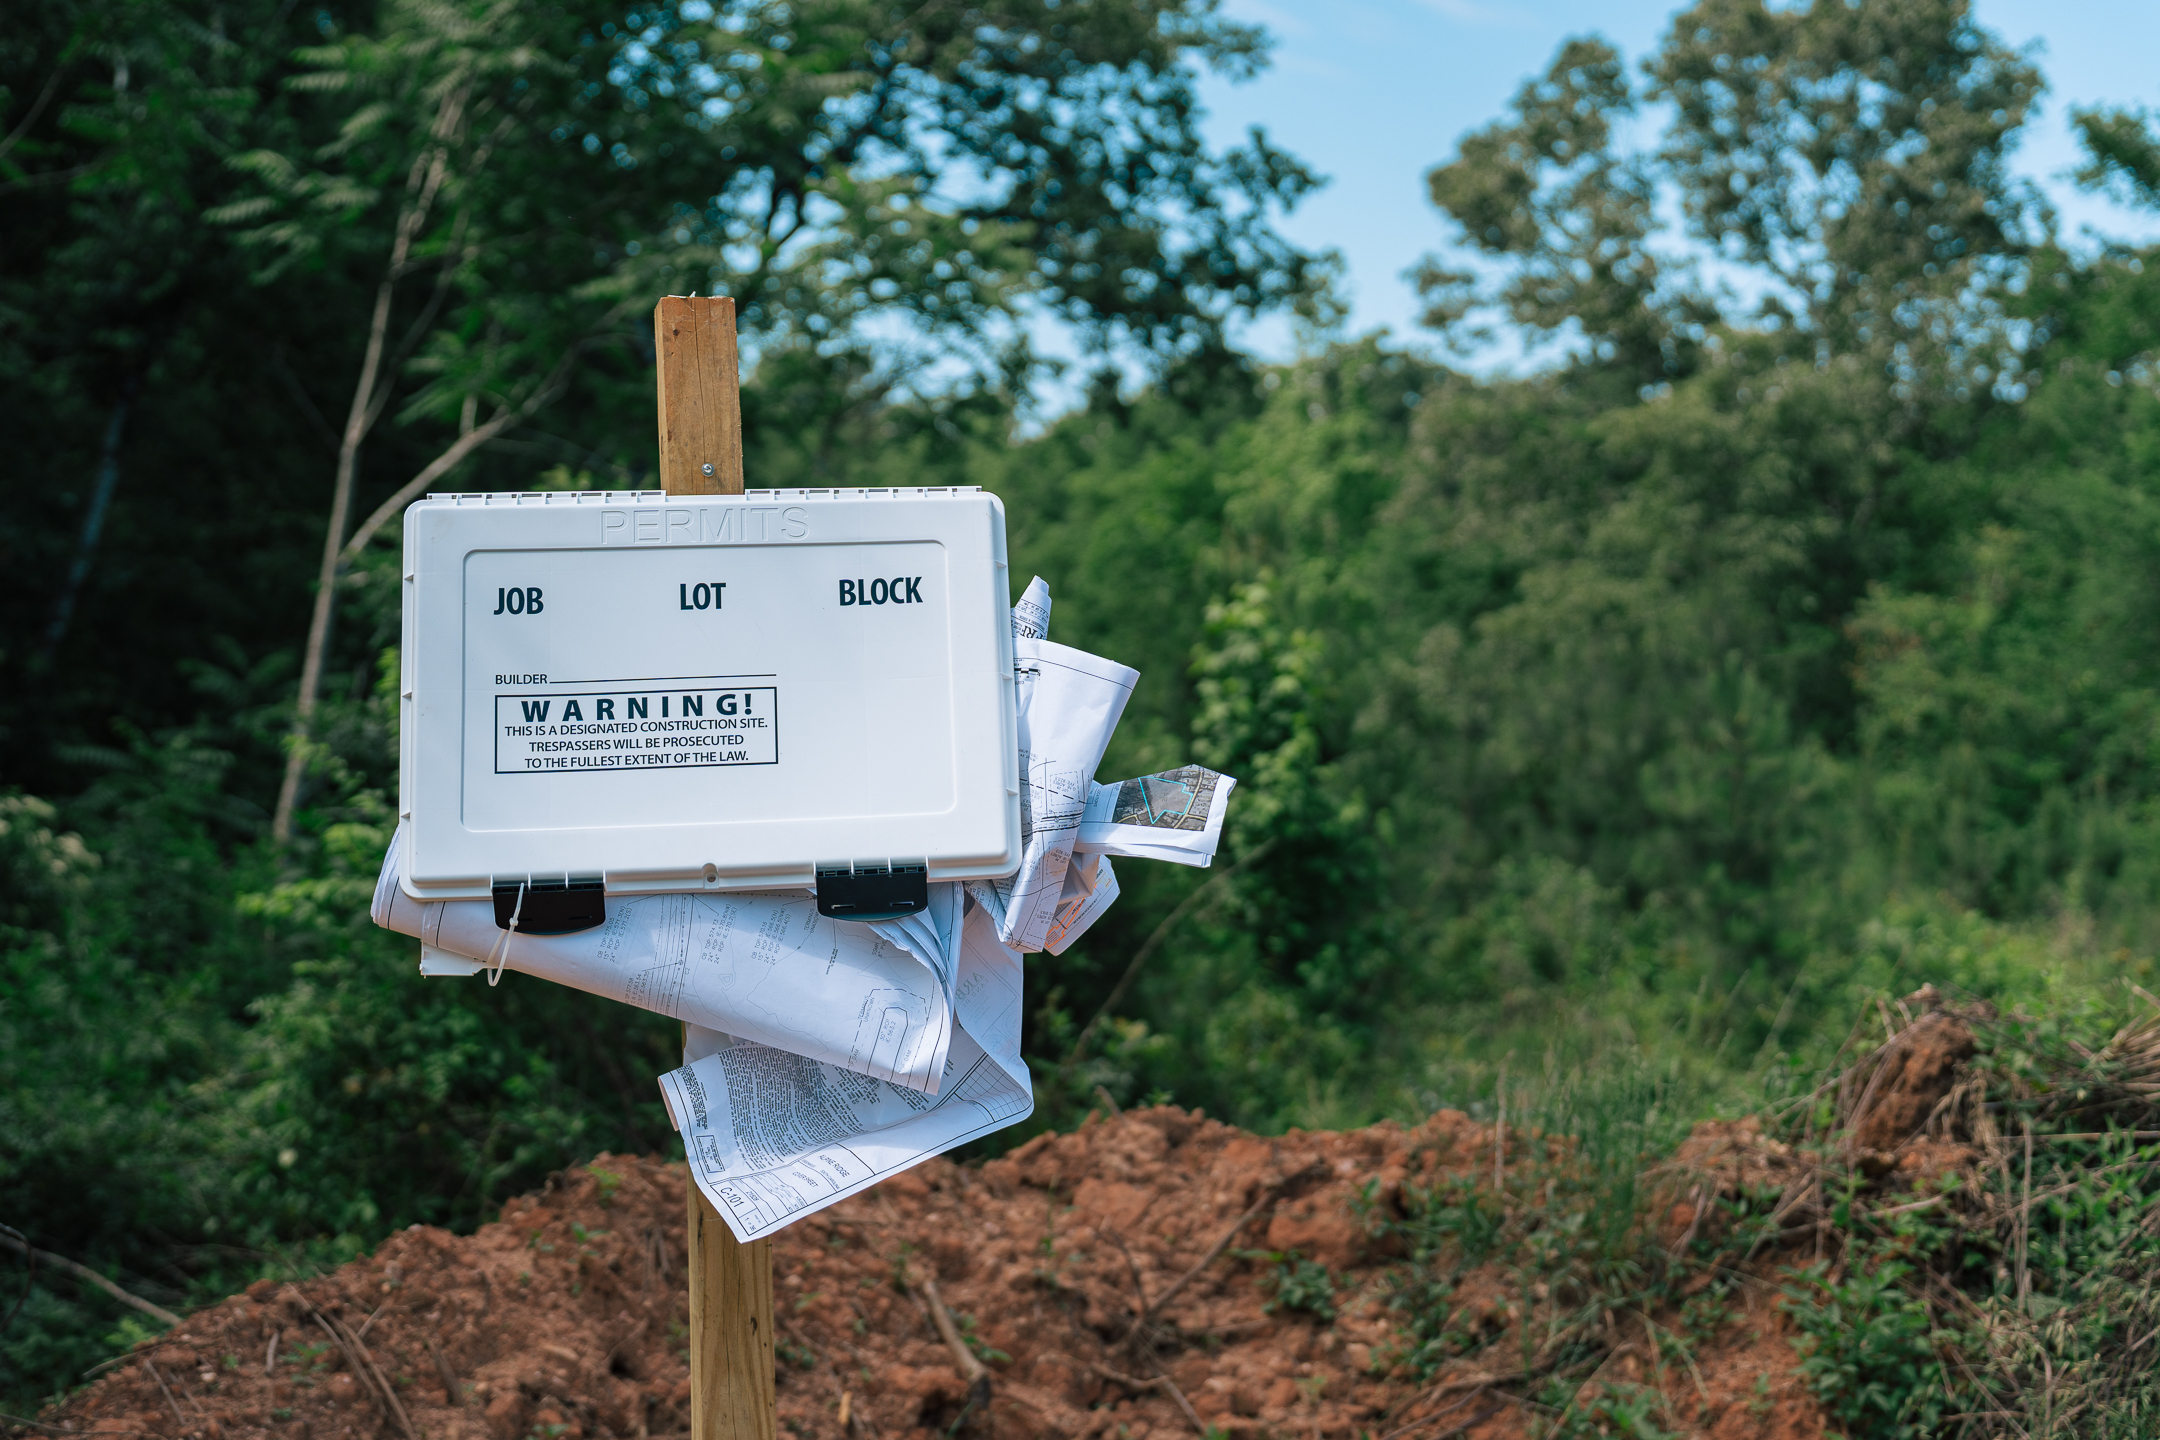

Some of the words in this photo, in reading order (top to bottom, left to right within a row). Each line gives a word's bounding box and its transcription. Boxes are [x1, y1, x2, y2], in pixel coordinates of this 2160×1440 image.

[600, 506, 810, 545] PERMITS
[493, 587, 543, 615] JOB
[680, 582, 726, 610] LOT
[838, 576, 923, 606] BLOCK
[495, 674, 547, 684] BUILDER
[521, 693, 752, 722] WARNING!
[505, 726, 532, 736] THIS
[535, 725, 546, 736] IS
[549, 725, 557, 735] A
[561, 723, 637, 735] DESIGNATED
[640, 719, 737, 732] CONSTRUCTION
[740, 717, 768, 728] SITE.
[529, 740, 611, 752] TRESPASSERS
[613, 738, 642, 750] WILL
[646, 738, 660, 748] BE
[663, 735, 744, 747] PROSECUTED
[525, 758, 541, 769] TO
[544, 757, 568, 768] THE
[571, 755, 620, 767] FULLEST
[625, 753, 671, 765] EXTENT
[674, 753, 690, 763] OF
[693, 752, 716, 762] THE
[719, 751, 749, 761] LAW.
[720, 1187, 744, 1208] C-101
